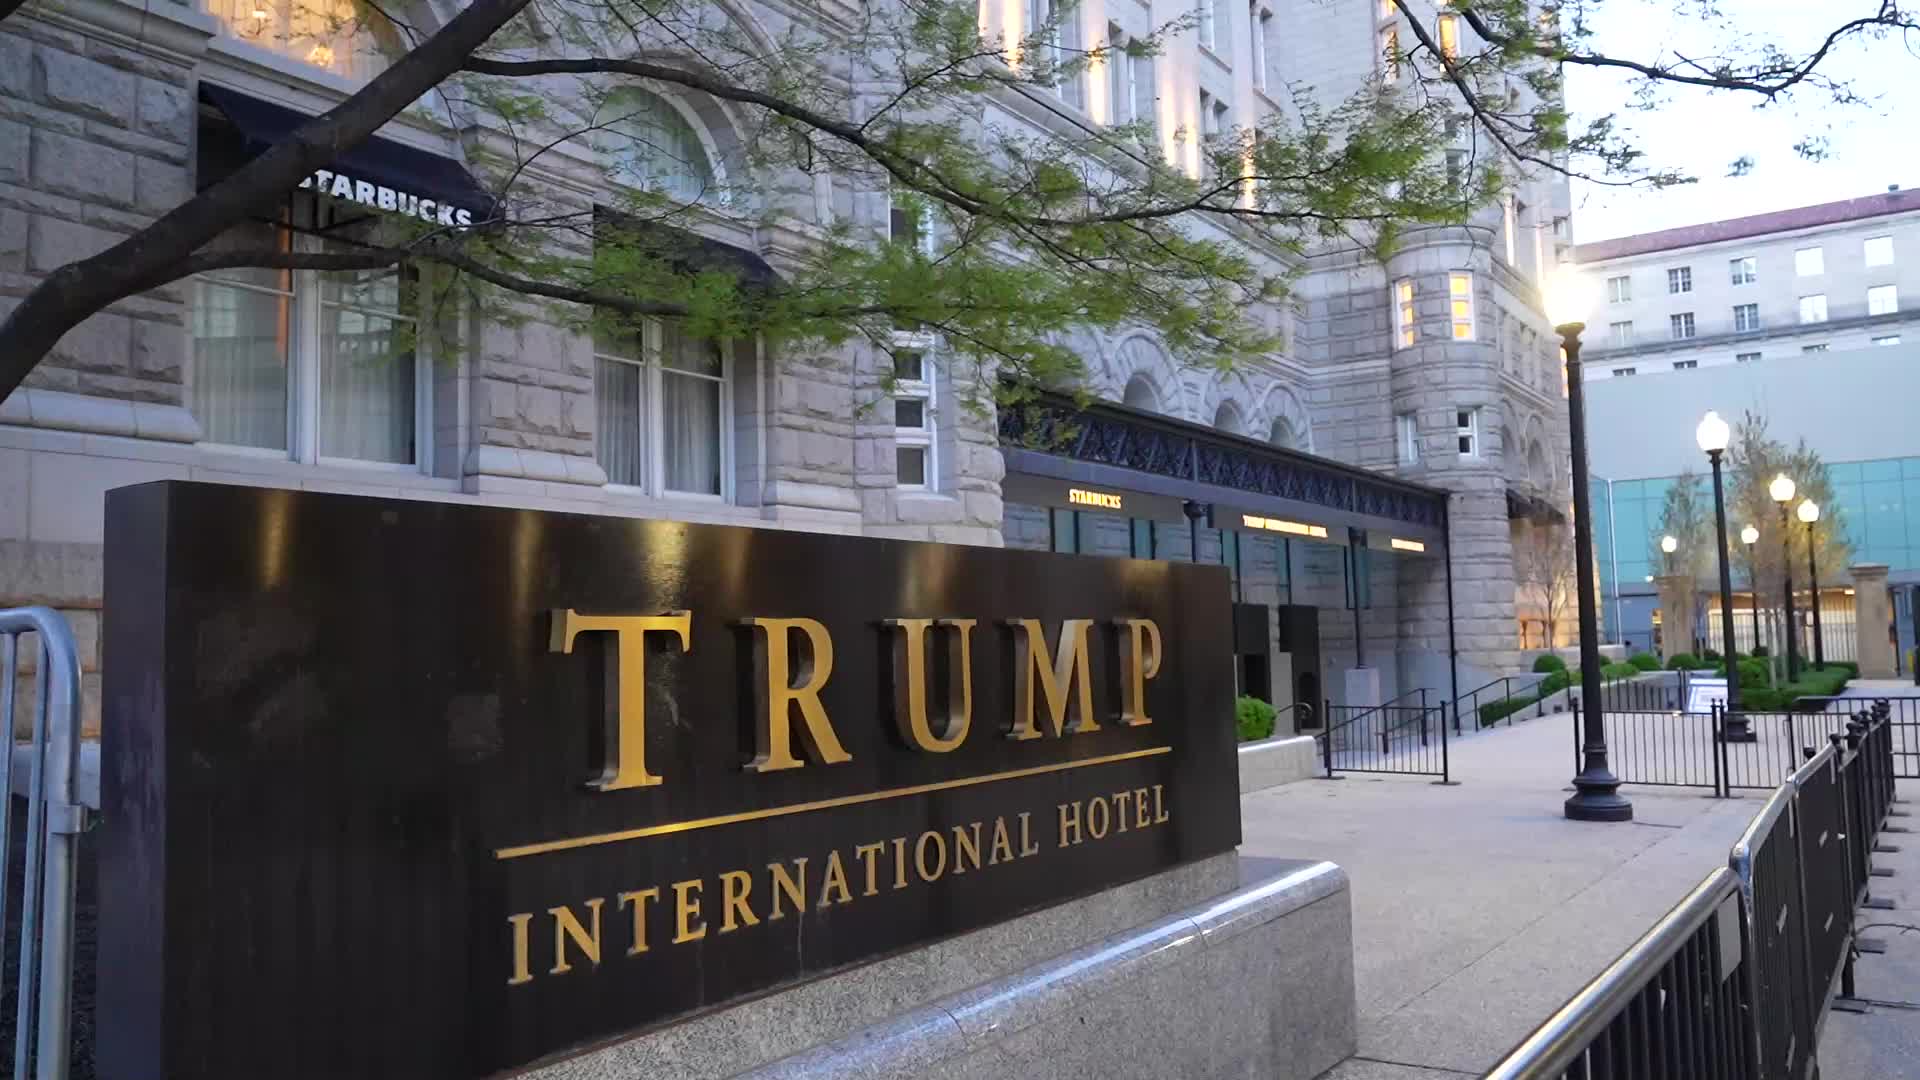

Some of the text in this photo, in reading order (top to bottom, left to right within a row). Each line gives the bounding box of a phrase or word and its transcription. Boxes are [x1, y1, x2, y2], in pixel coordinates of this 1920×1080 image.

[549, 608, 1162, 792] TRUMP
[507, 784, 1169, 984] INTERNATIONAL HOTEL
